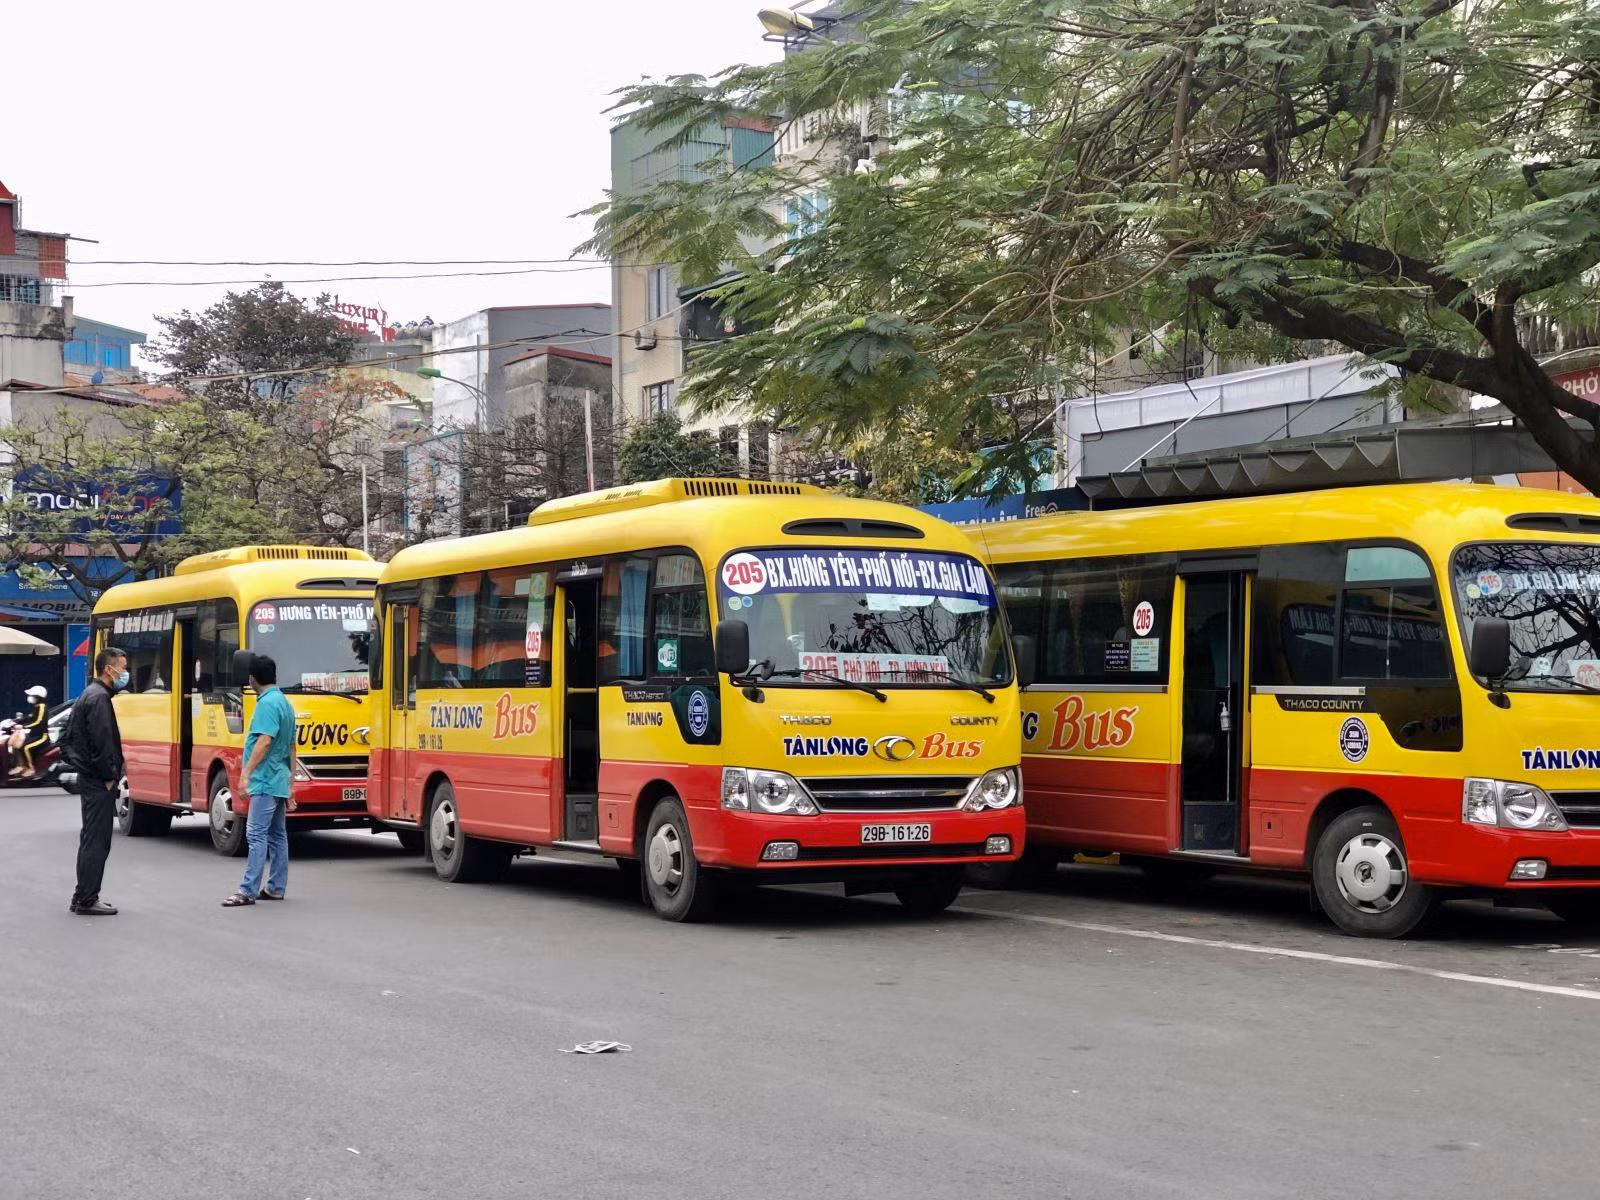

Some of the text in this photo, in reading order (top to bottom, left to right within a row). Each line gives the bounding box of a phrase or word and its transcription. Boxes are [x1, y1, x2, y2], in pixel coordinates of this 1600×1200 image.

[1025, 504, 1046, 518] Free
[725, 562, 763, 585] 205
[765, 554, 830, 588] BX.HƯNG
[961, 560, 989, 595] LÂM
[255, 608, 274, 619] 205
[279, 605, 312, 620] HƯNG
[314, 603, 364, 619] YÊN-PHỐ
[1136, 609, 1151, 629] 205
[527, 631, 540, 653] 205
[803, 656, 838, 681] 205
[430, 699, 482, 728] TÂN LONG
[493, 693, 538, 739] Bus
[1285, 700, 1364, 710] THACO COUNTY
[780, 715, 832, 725] THACO
[950, 716, 999, 726] COUNTY
[1047, 695, 1138, 751] Bus
[296, 722, 349, 750] ƯỢNG
[784, 735, 868, 756] TÂNLONG
[918, 732, 983, 759] Bus
[1522, 747, 1600, 769] TÂNLON
[863, 825, 929, 842] 29B-161.26
